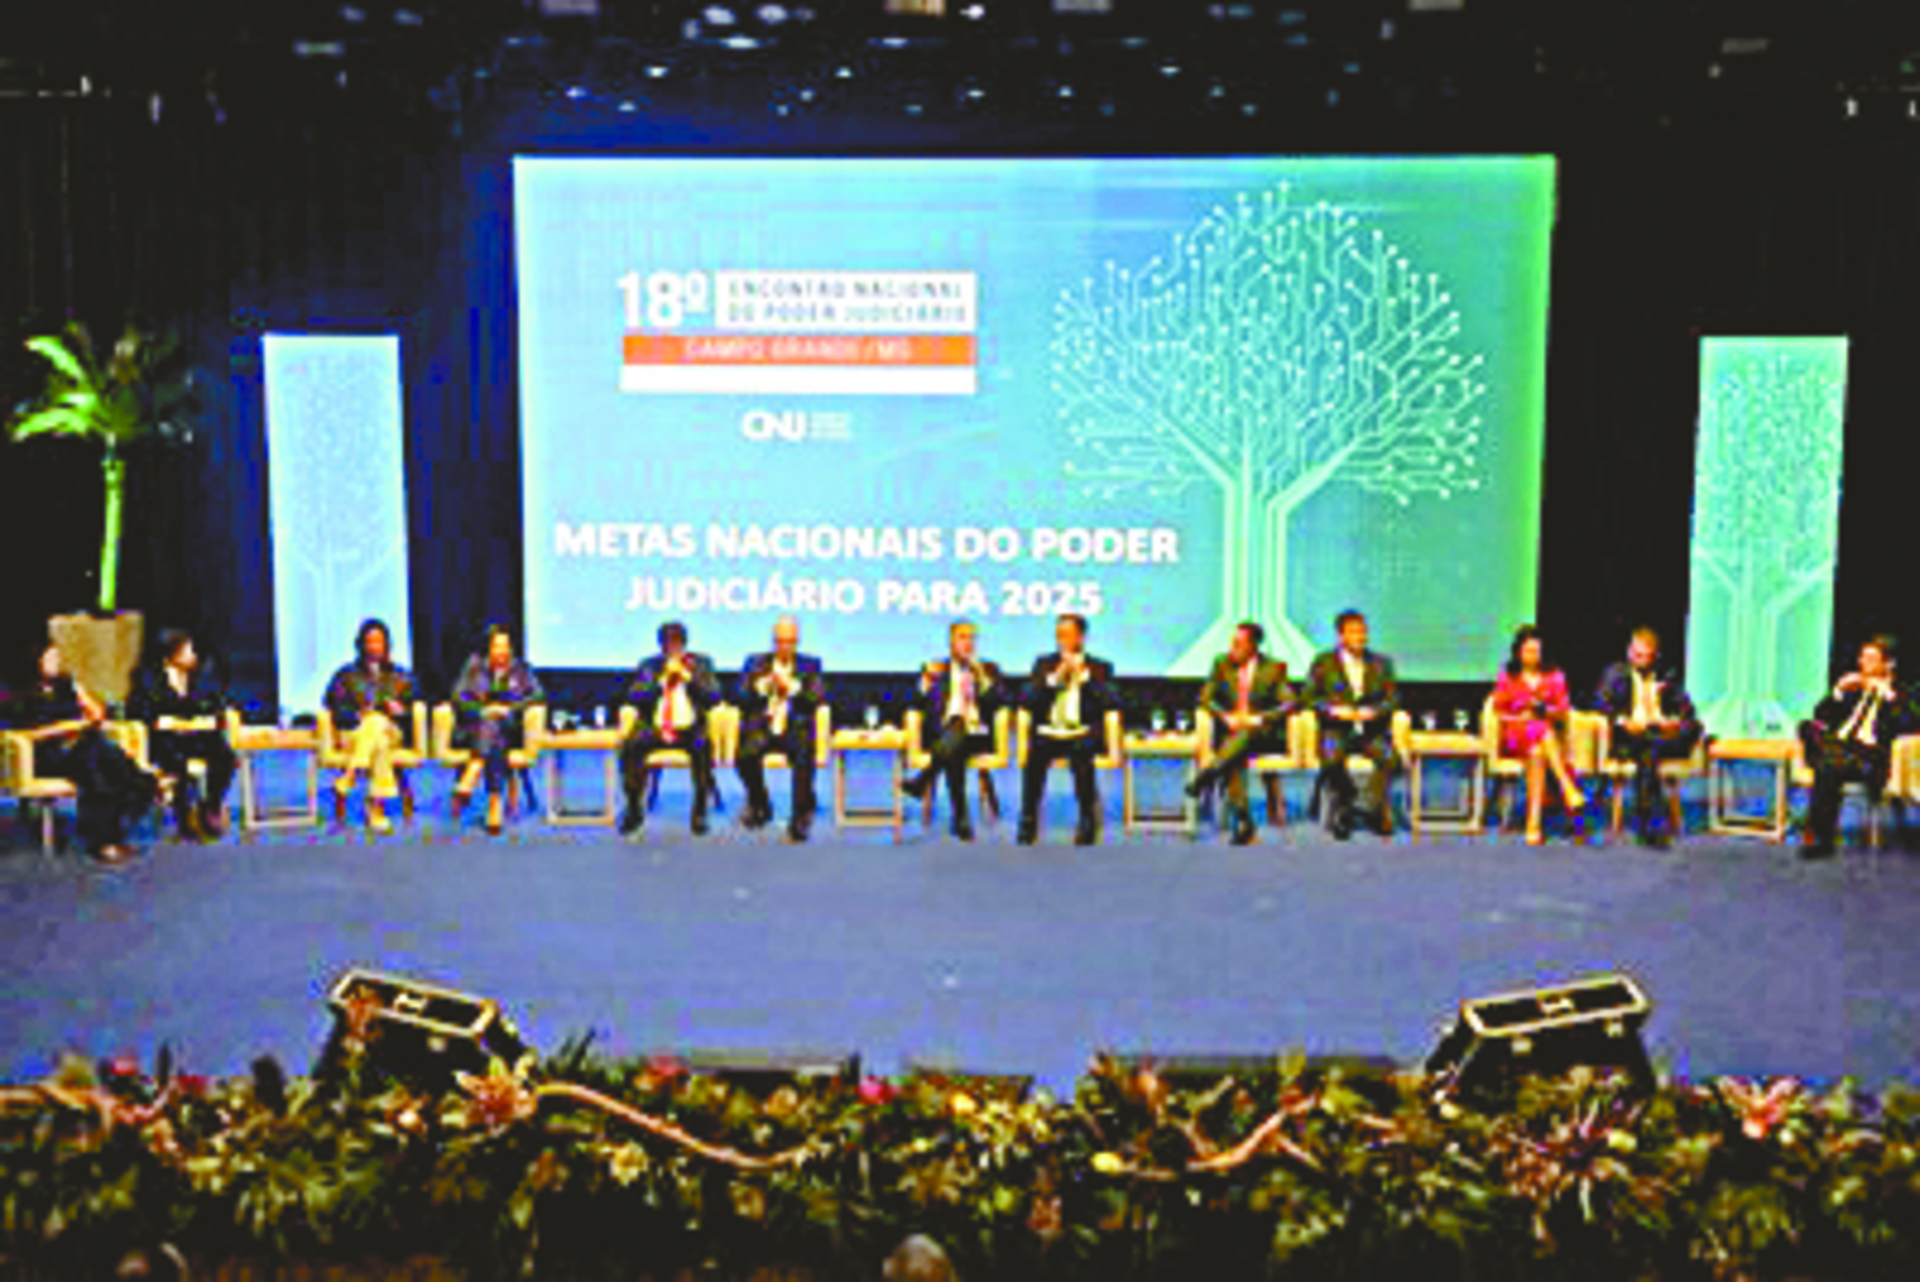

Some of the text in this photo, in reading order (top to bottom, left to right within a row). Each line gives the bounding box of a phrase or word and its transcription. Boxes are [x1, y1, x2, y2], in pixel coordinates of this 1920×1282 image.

[555, 522, 1178, 564] METAS NACIONAIS DO PODER
[625, 571, 1102, 616] JUDICIÁRIO PARA 2025
